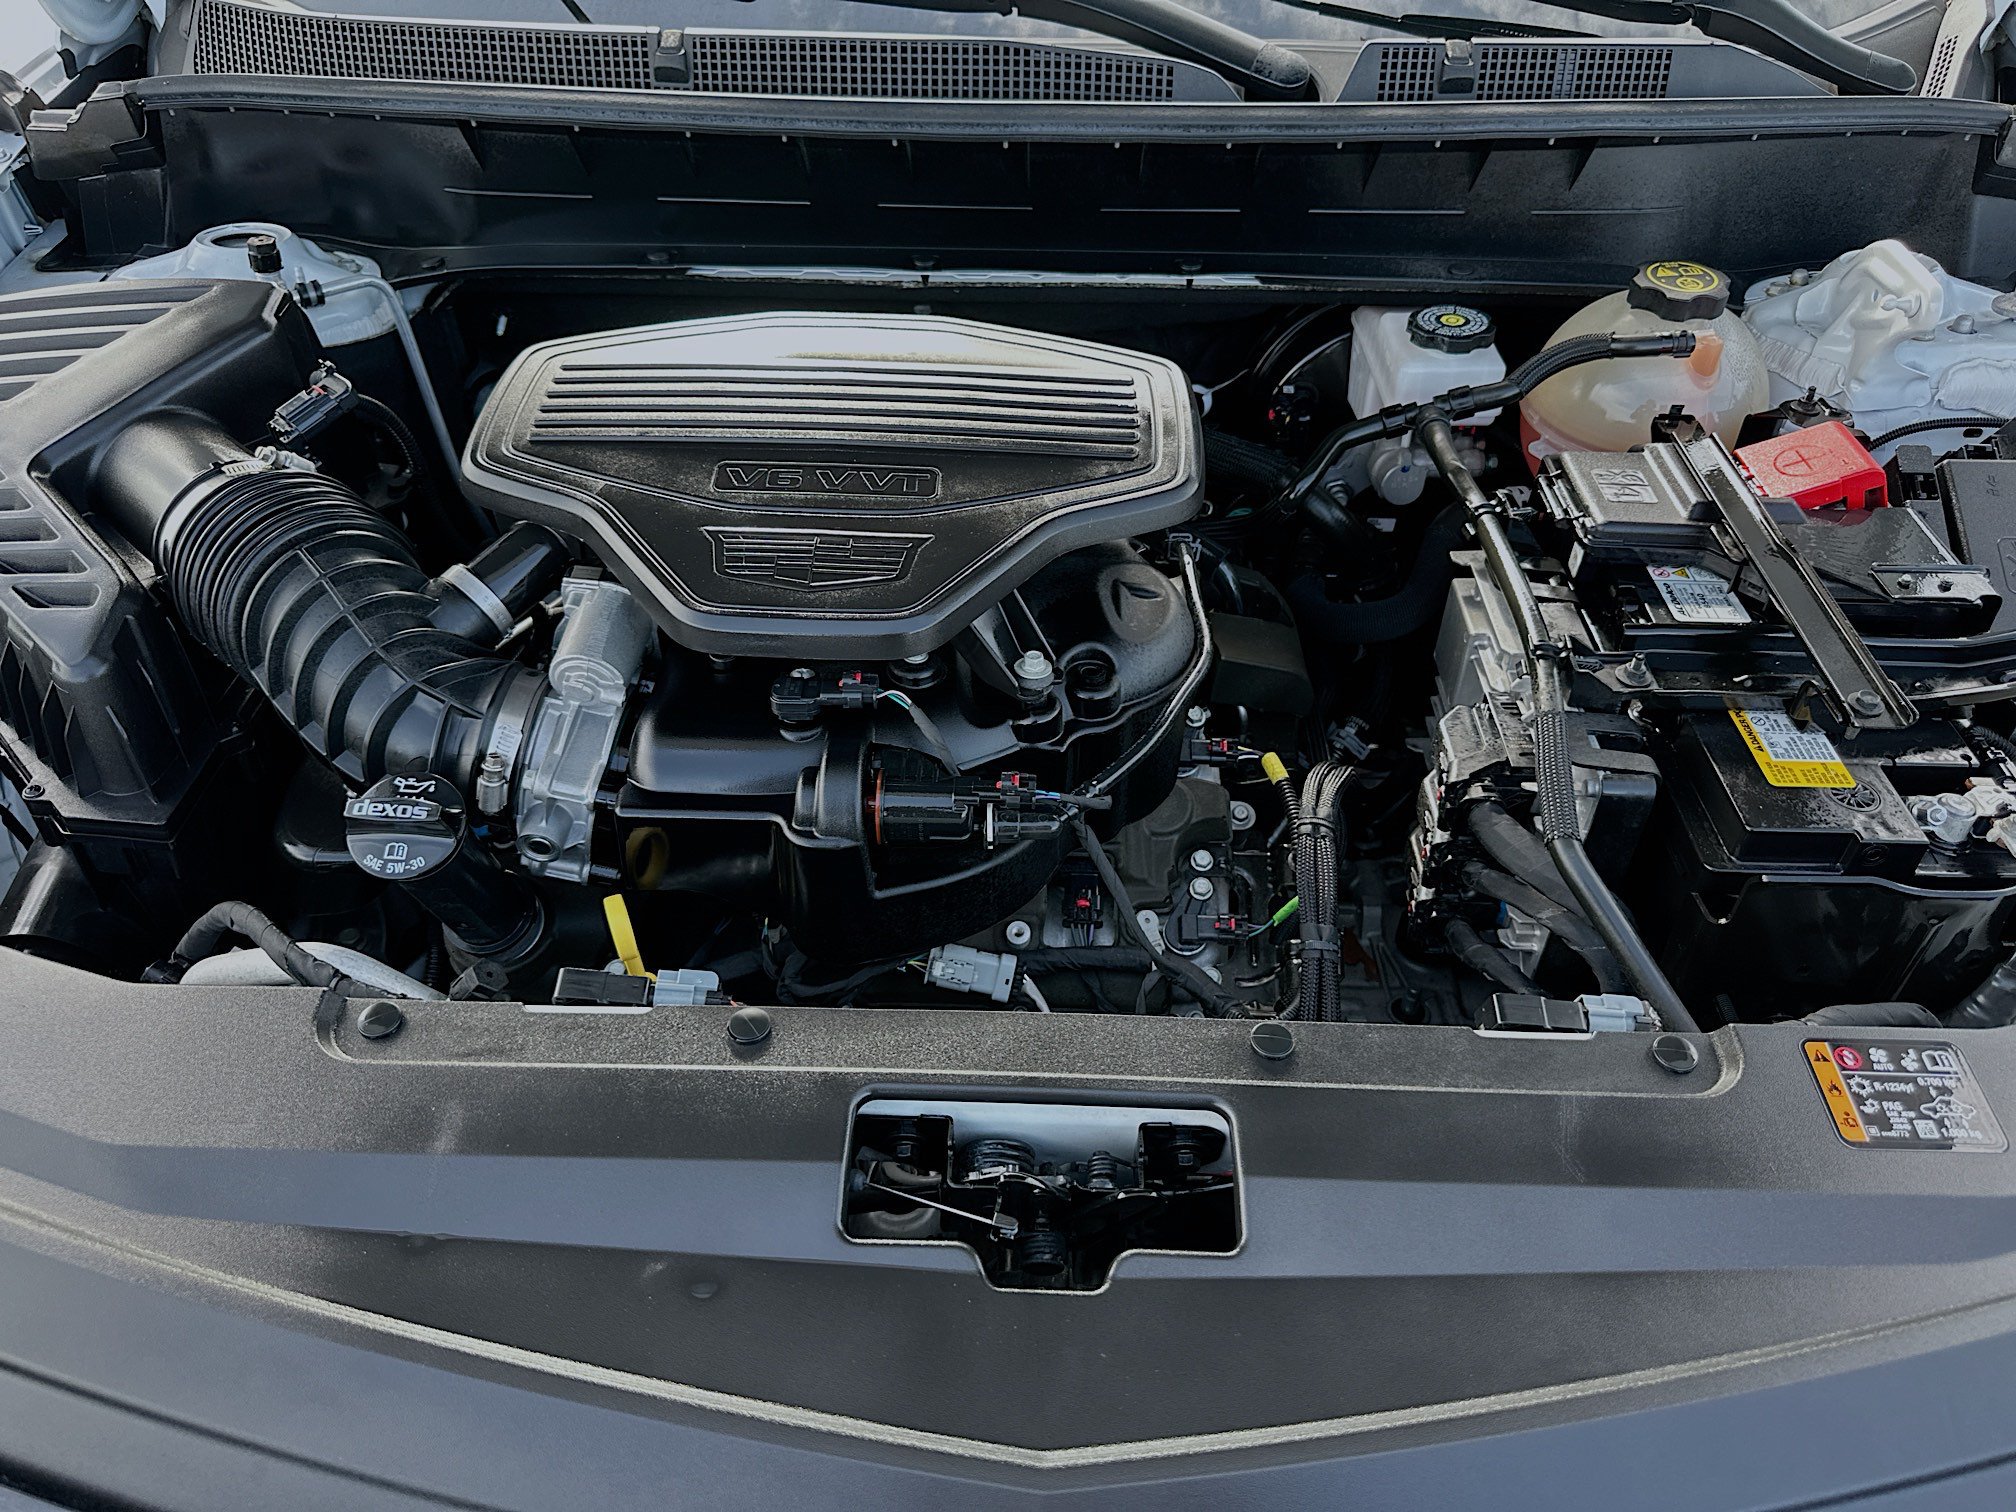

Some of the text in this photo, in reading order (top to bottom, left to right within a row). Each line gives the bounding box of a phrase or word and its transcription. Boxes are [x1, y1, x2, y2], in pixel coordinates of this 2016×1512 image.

[726, 467, 930, 493] V6 VVT
[1739, 719, 1762, 745] DANGER
[352, 799, 431, 819] dexos
[363, 854, 426, 874] SAE 5W-30
[1873, 1063, 1894, 1071] AUTO
[1882, 1101, 1903, 1111] PAG
[1969, 1128, 1983, 1140] kg
